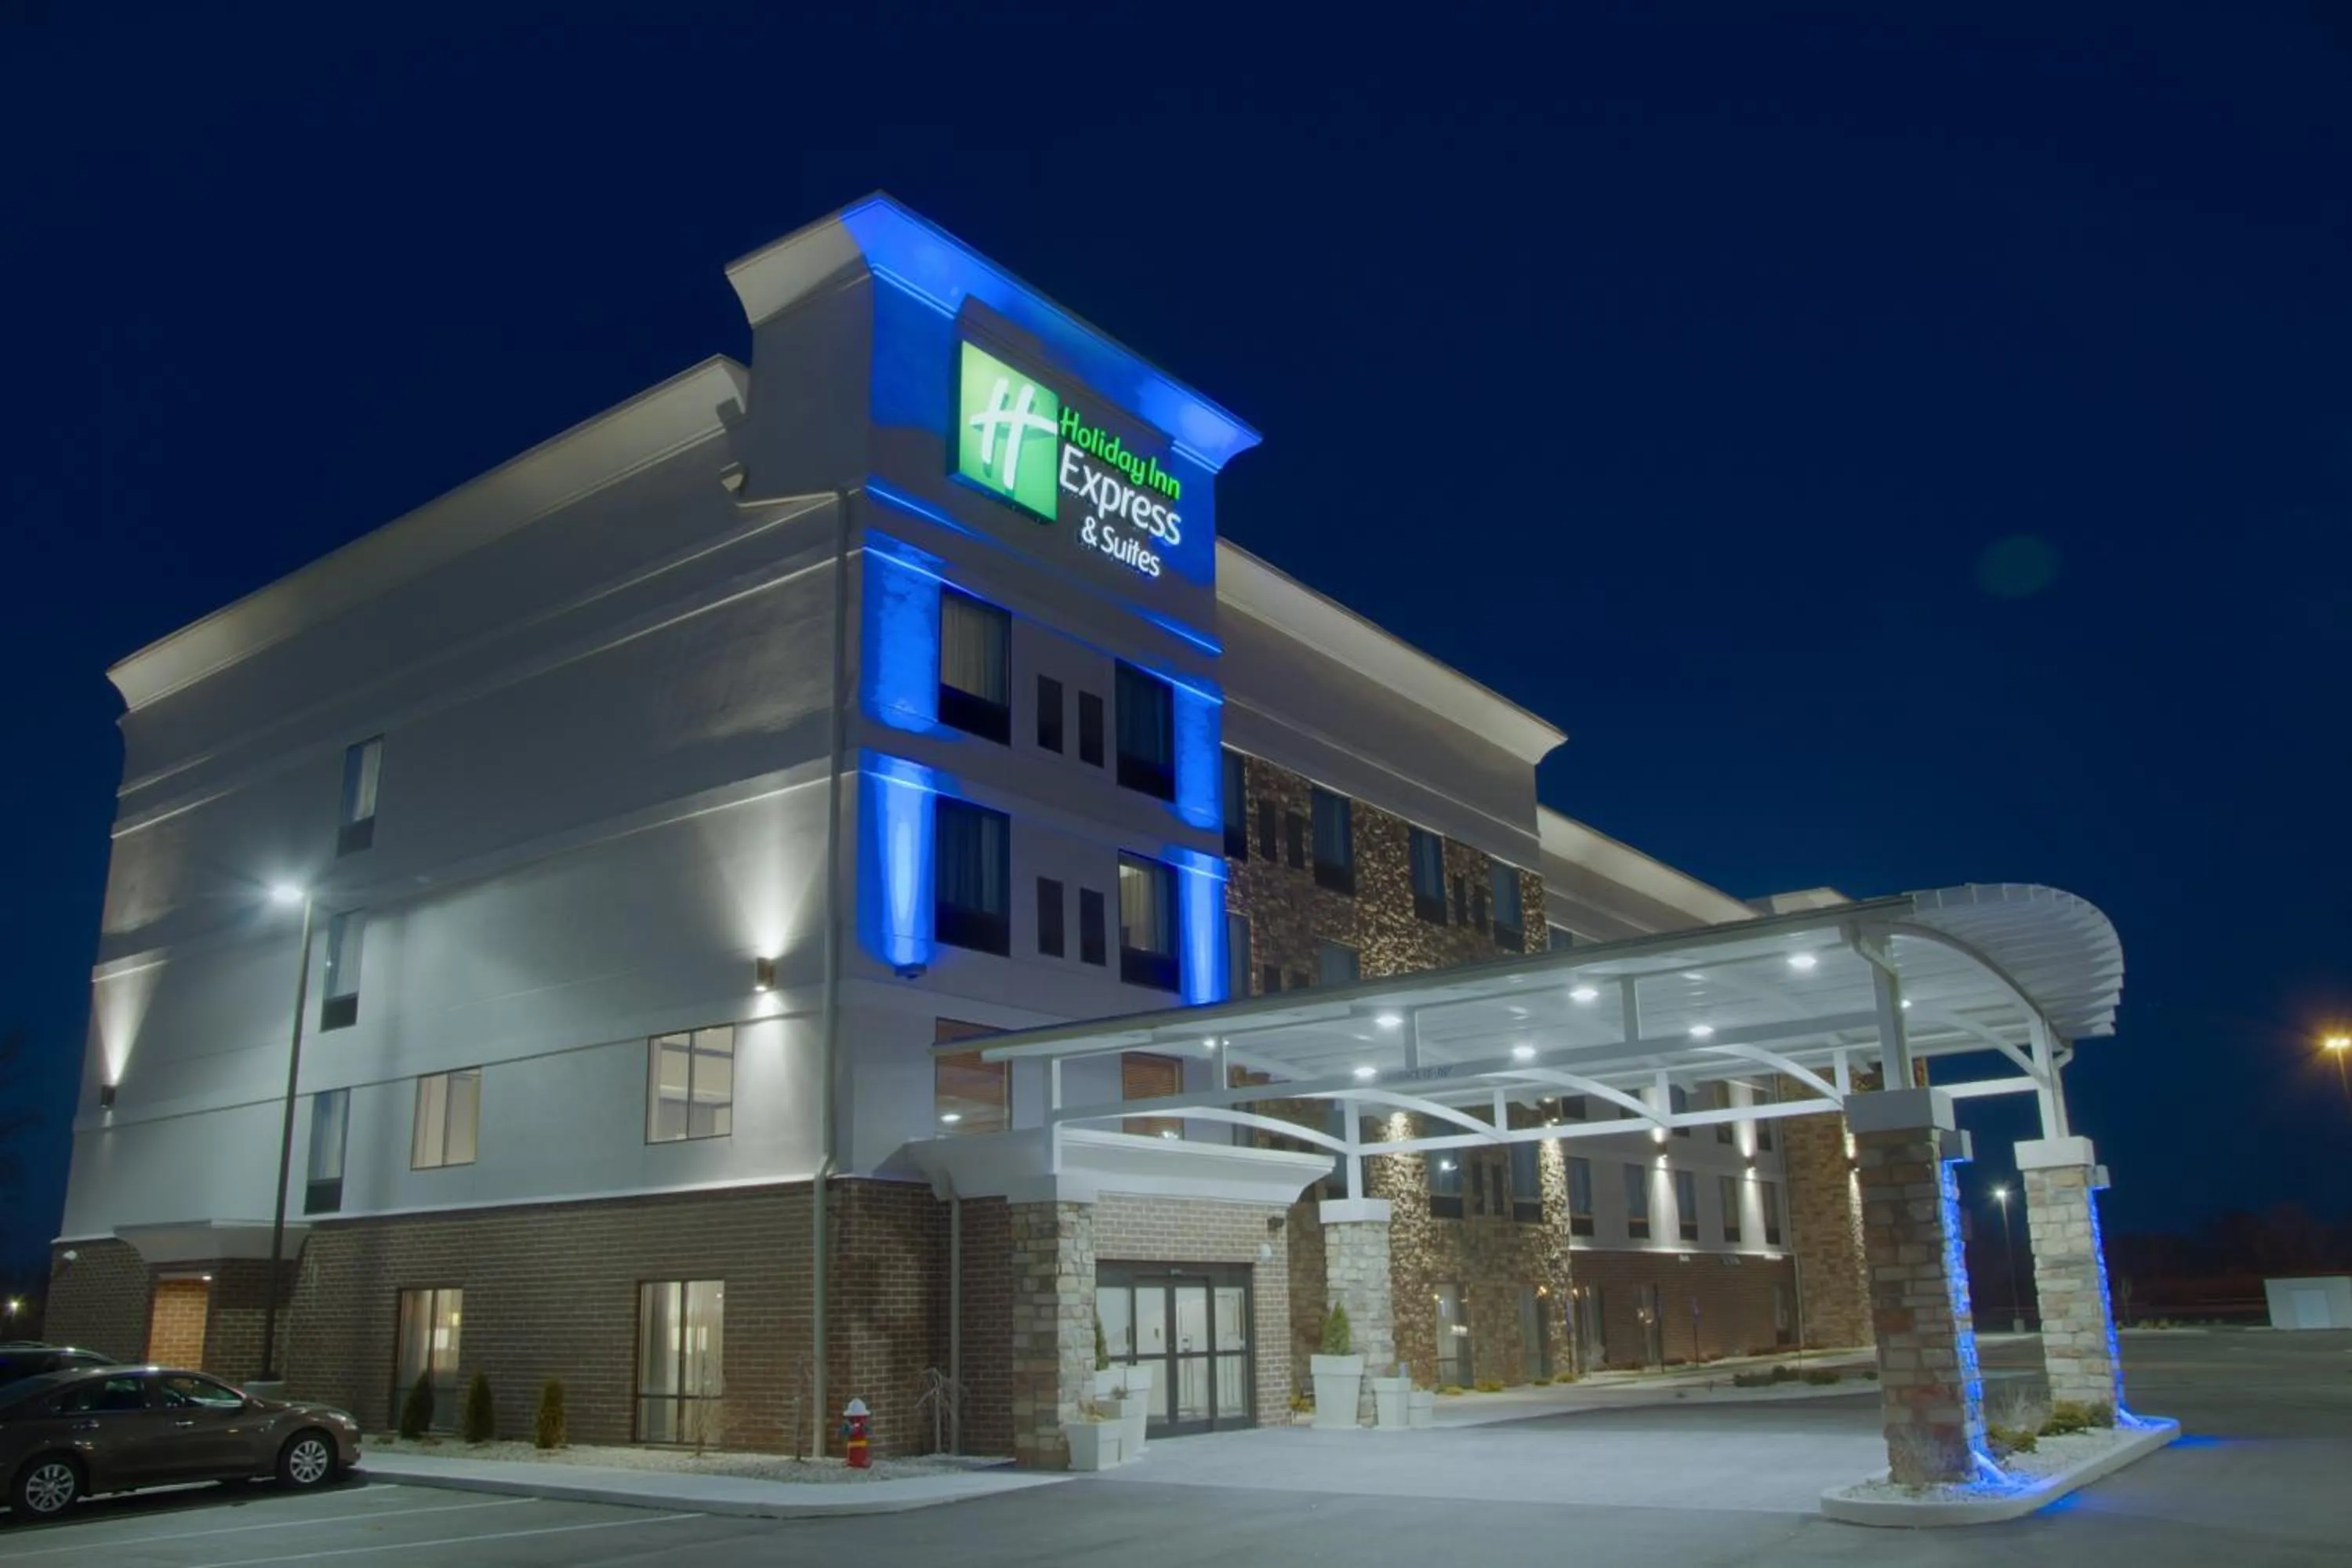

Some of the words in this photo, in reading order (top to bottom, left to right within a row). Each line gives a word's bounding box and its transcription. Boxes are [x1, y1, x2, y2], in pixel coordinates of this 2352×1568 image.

[1059, 443, 1181, 545] Express
[1060, 406, 1145, 485] Holiday
[1149, 455, 1180, 499] Inn
[1081, 515, 1098, 546] &
[1101, 525, 1160, 577] Suites
